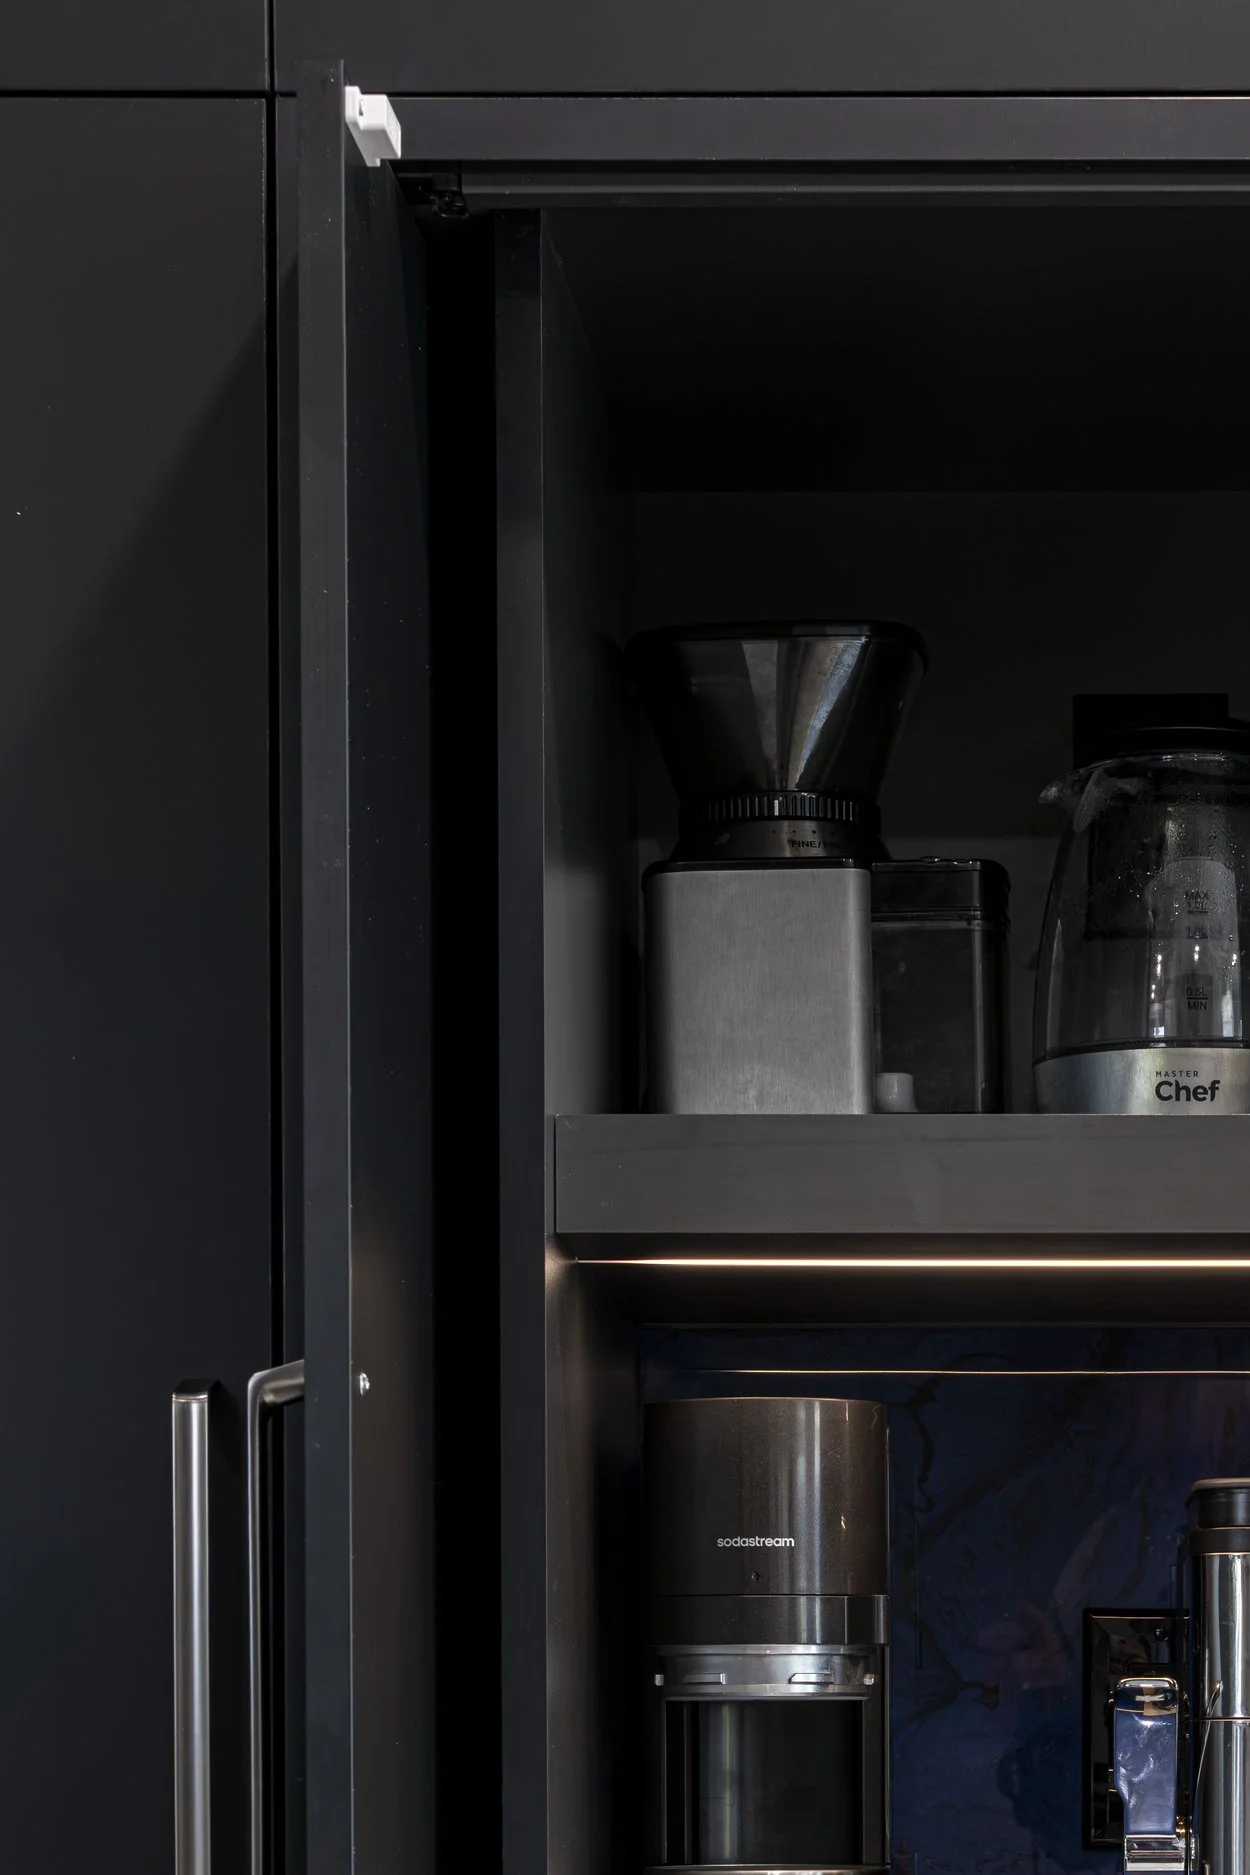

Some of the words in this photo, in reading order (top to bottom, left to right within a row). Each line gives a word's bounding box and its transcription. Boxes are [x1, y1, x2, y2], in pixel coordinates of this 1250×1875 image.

[1187, 1001, 1207, 1010] MIN
[1155, 1070, 1199, 1078] MASTER
[1155, 1080, 1221, 1102] Chef
[717, 1536, 795, 1547] sodastream
